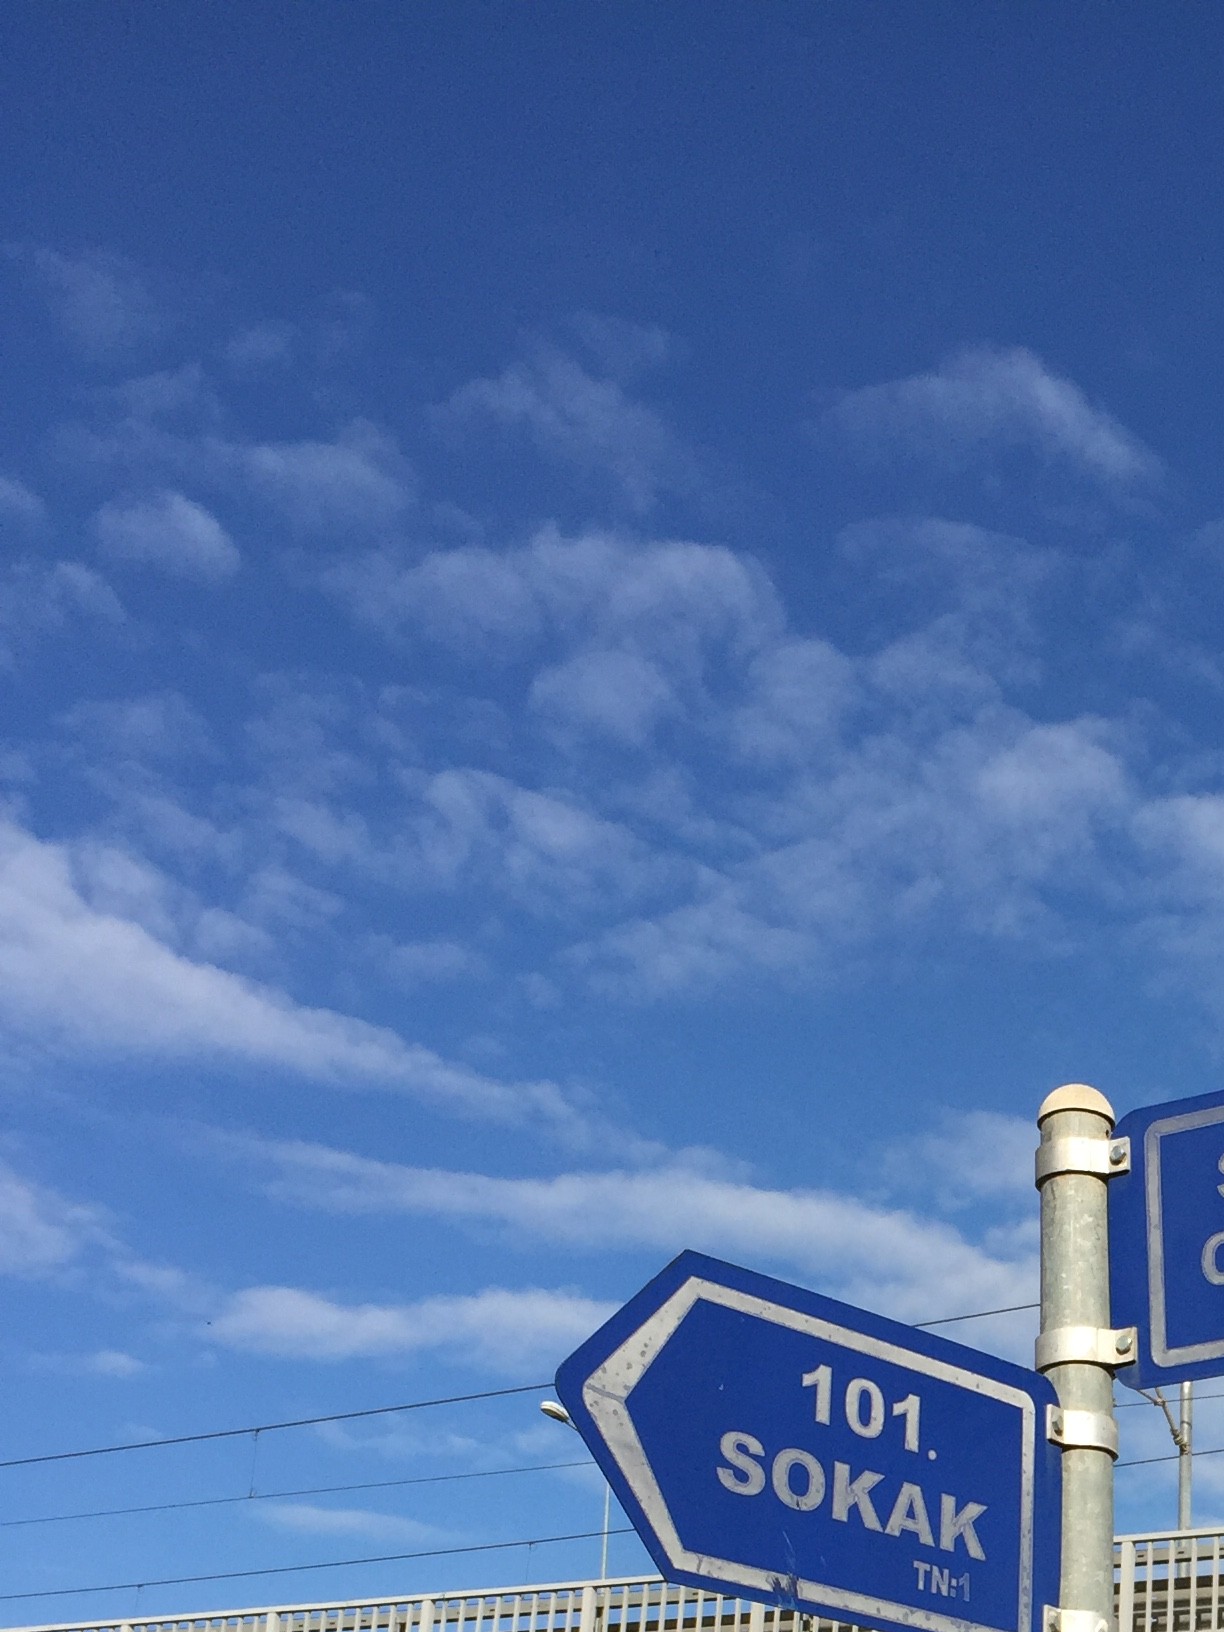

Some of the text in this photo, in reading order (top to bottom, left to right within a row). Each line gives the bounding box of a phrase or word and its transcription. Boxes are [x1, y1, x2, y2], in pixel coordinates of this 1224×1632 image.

[801, 1364, 938, 1461] 101.
[716, 1430, 989, 1561] SOKAK
[913, 1560, 970, 1602] TN:1
